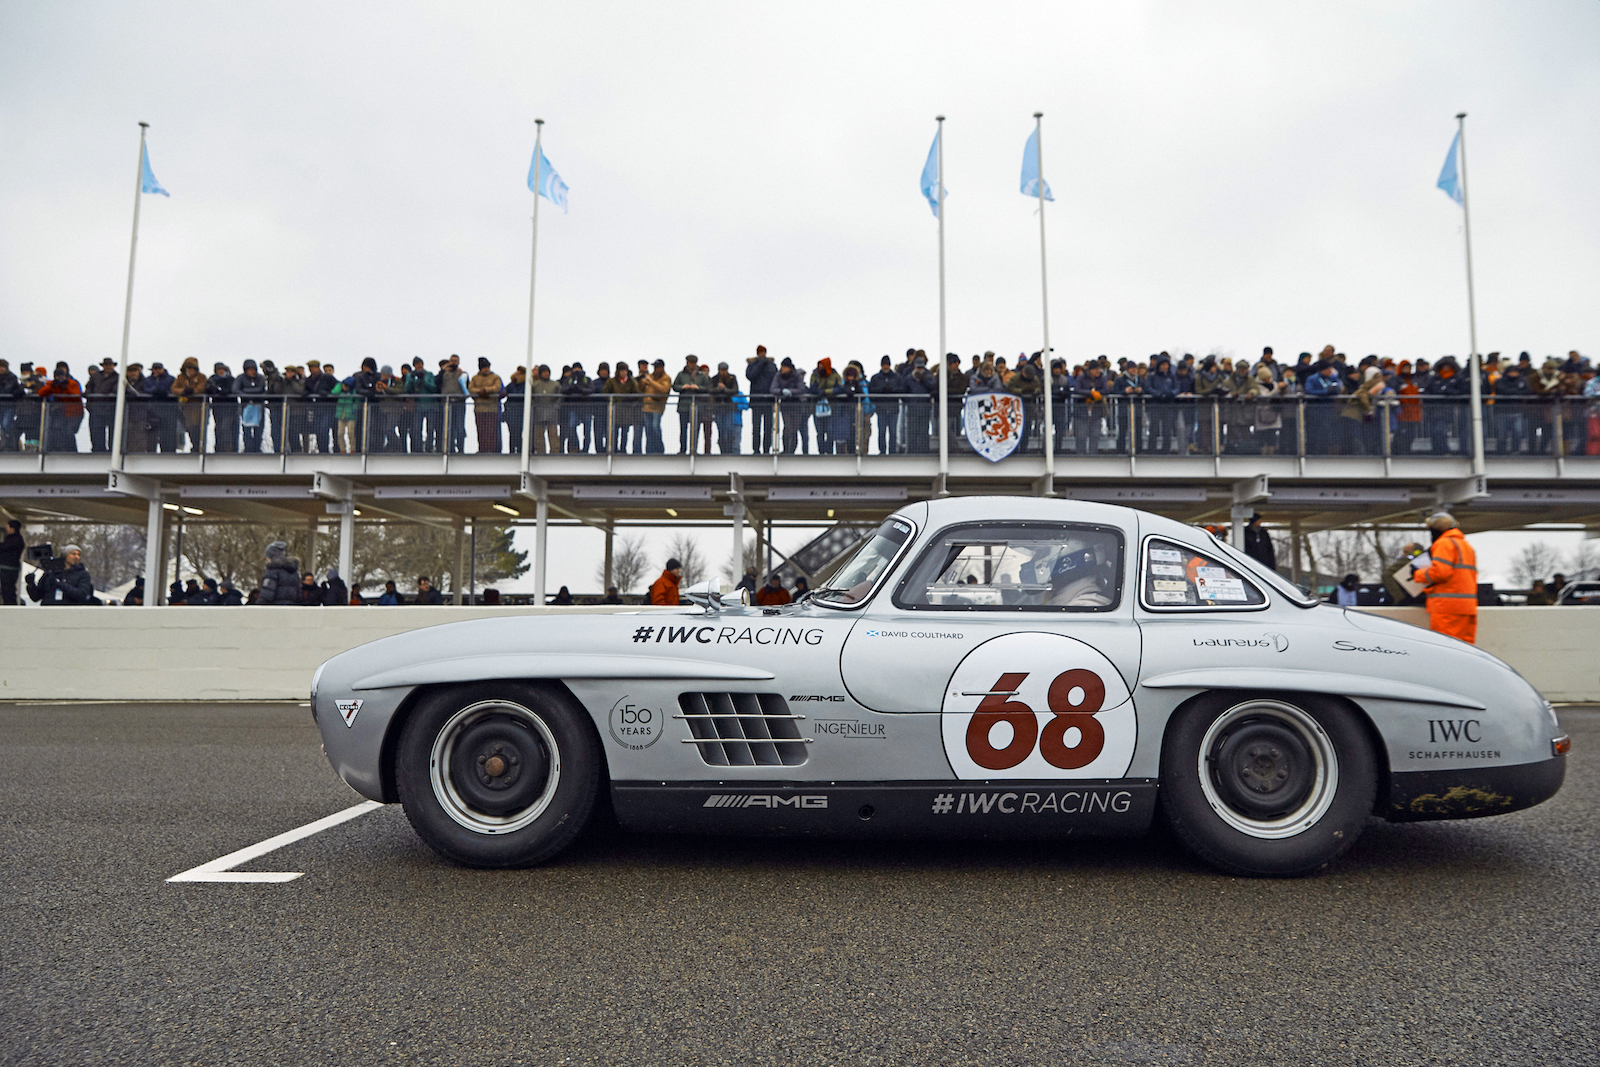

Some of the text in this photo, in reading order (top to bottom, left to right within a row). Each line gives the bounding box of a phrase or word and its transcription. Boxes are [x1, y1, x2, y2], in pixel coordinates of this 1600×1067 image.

[111, 474, 118, 488] 3
[316, 475, 322, 489] 4
[632, 626, 824, 646] #IWCRACING
[881, 630, 964, 640] DAVID COULTHARD
[1332, 640, 1410, 656] Santoni
[619, 704, 652, 724] 150
[965, 668, 1106, 771] 68
[620, 727, 652, 735] YEARS
[814, 721, 886, 736] INGENIEUR
[1428, 719, 1481, 743] IWC
[1408, 750, 1501, 759] SCHAFFHAUSEN
[931, 791, 1132, 814] #IWCRACING
